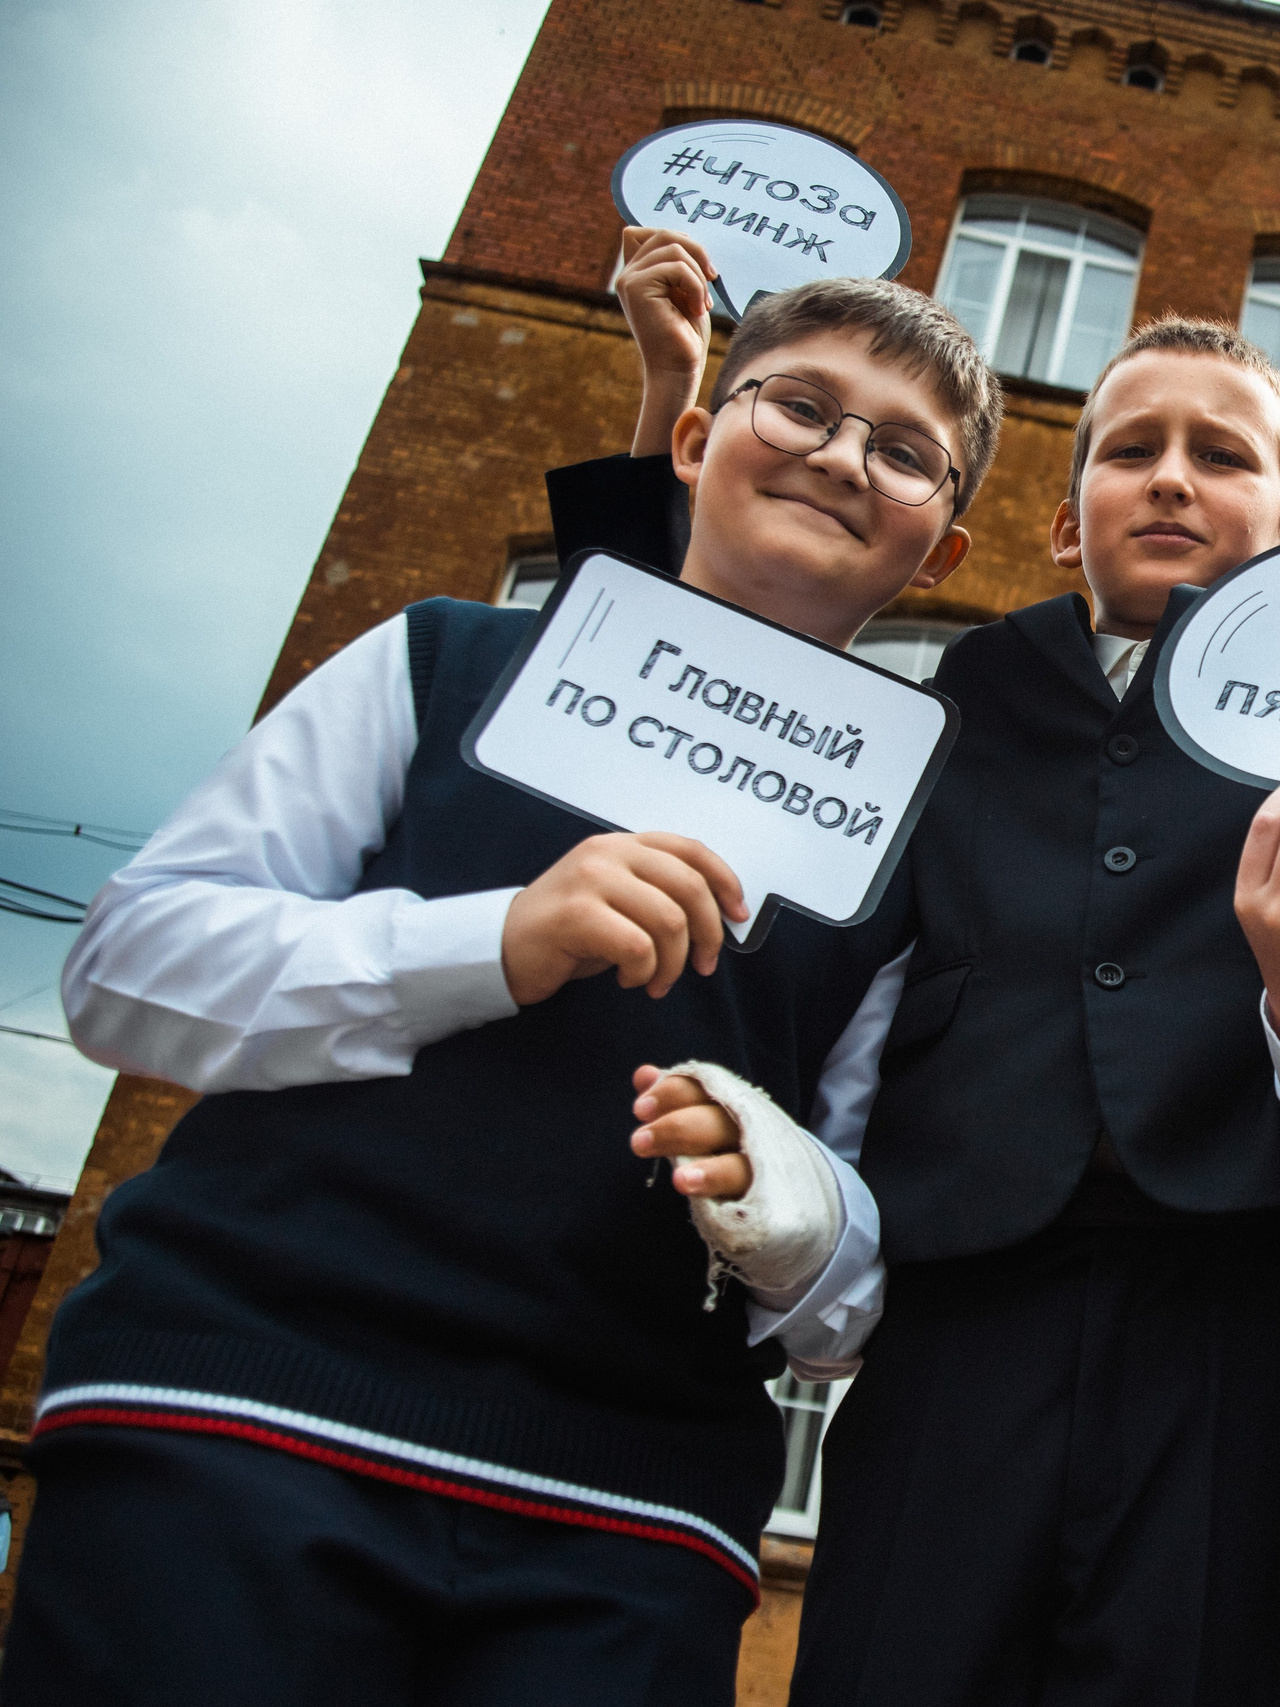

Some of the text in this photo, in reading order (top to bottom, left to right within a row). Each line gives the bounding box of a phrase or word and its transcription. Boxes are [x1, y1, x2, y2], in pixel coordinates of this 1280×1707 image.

[653, 186, 834, 263] Кринж
[663, 147, 877, 231] #ЧтоЗа
[638, 639, 865, 770] Главный
[544, 678, 884, 846] по столовой
